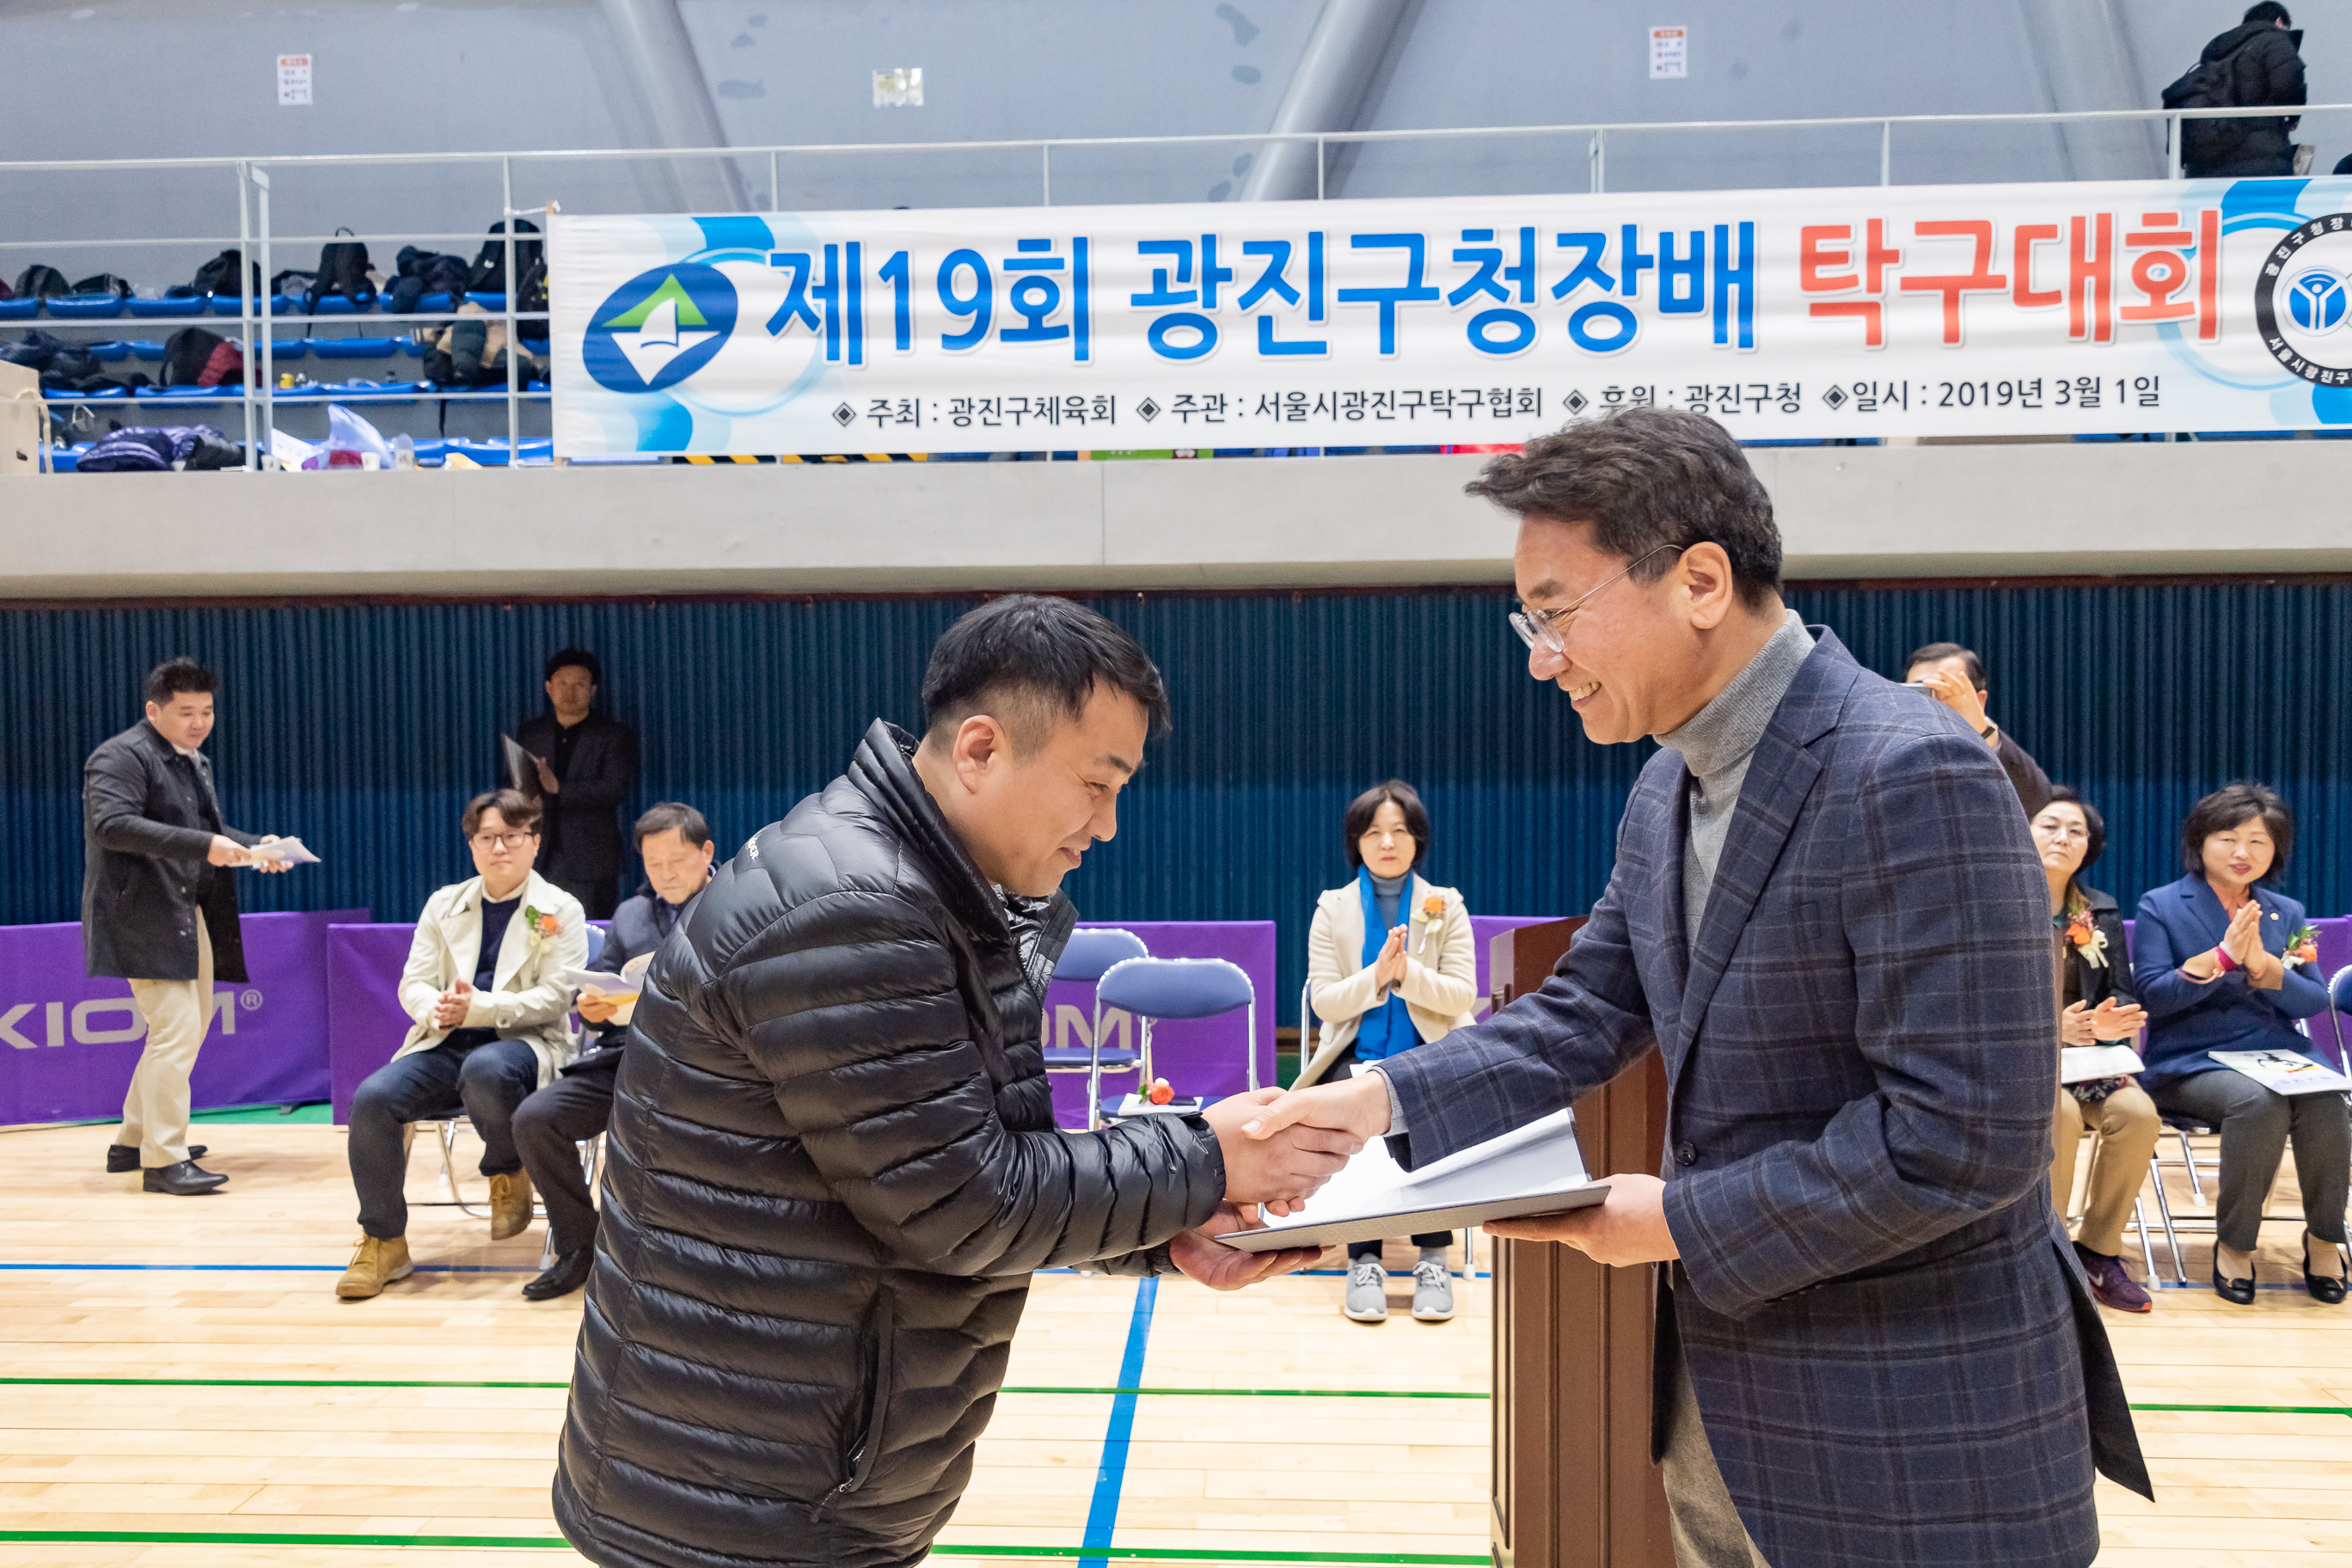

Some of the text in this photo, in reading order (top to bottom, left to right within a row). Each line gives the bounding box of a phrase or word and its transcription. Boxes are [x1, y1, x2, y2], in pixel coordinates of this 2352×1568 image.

[2264, 216, 2352, 277] 광진구청장
[768, 210, 2219, 365] 제19회 광진구청장배 탁구대회
[2269, 336, 2352, 385] 서울시광진구
[1255, 387, 1542, 422] 서울시광진구탁구협회
[1682, 383, 1801, 419] 광진구청
[1939, 377, 2043, 408] 2019년
[2055, 377, 2101, 408] 3월
[2116, 376, 2159, 407] 1일
[948, 395, 1116, 427] 광진구체육회
